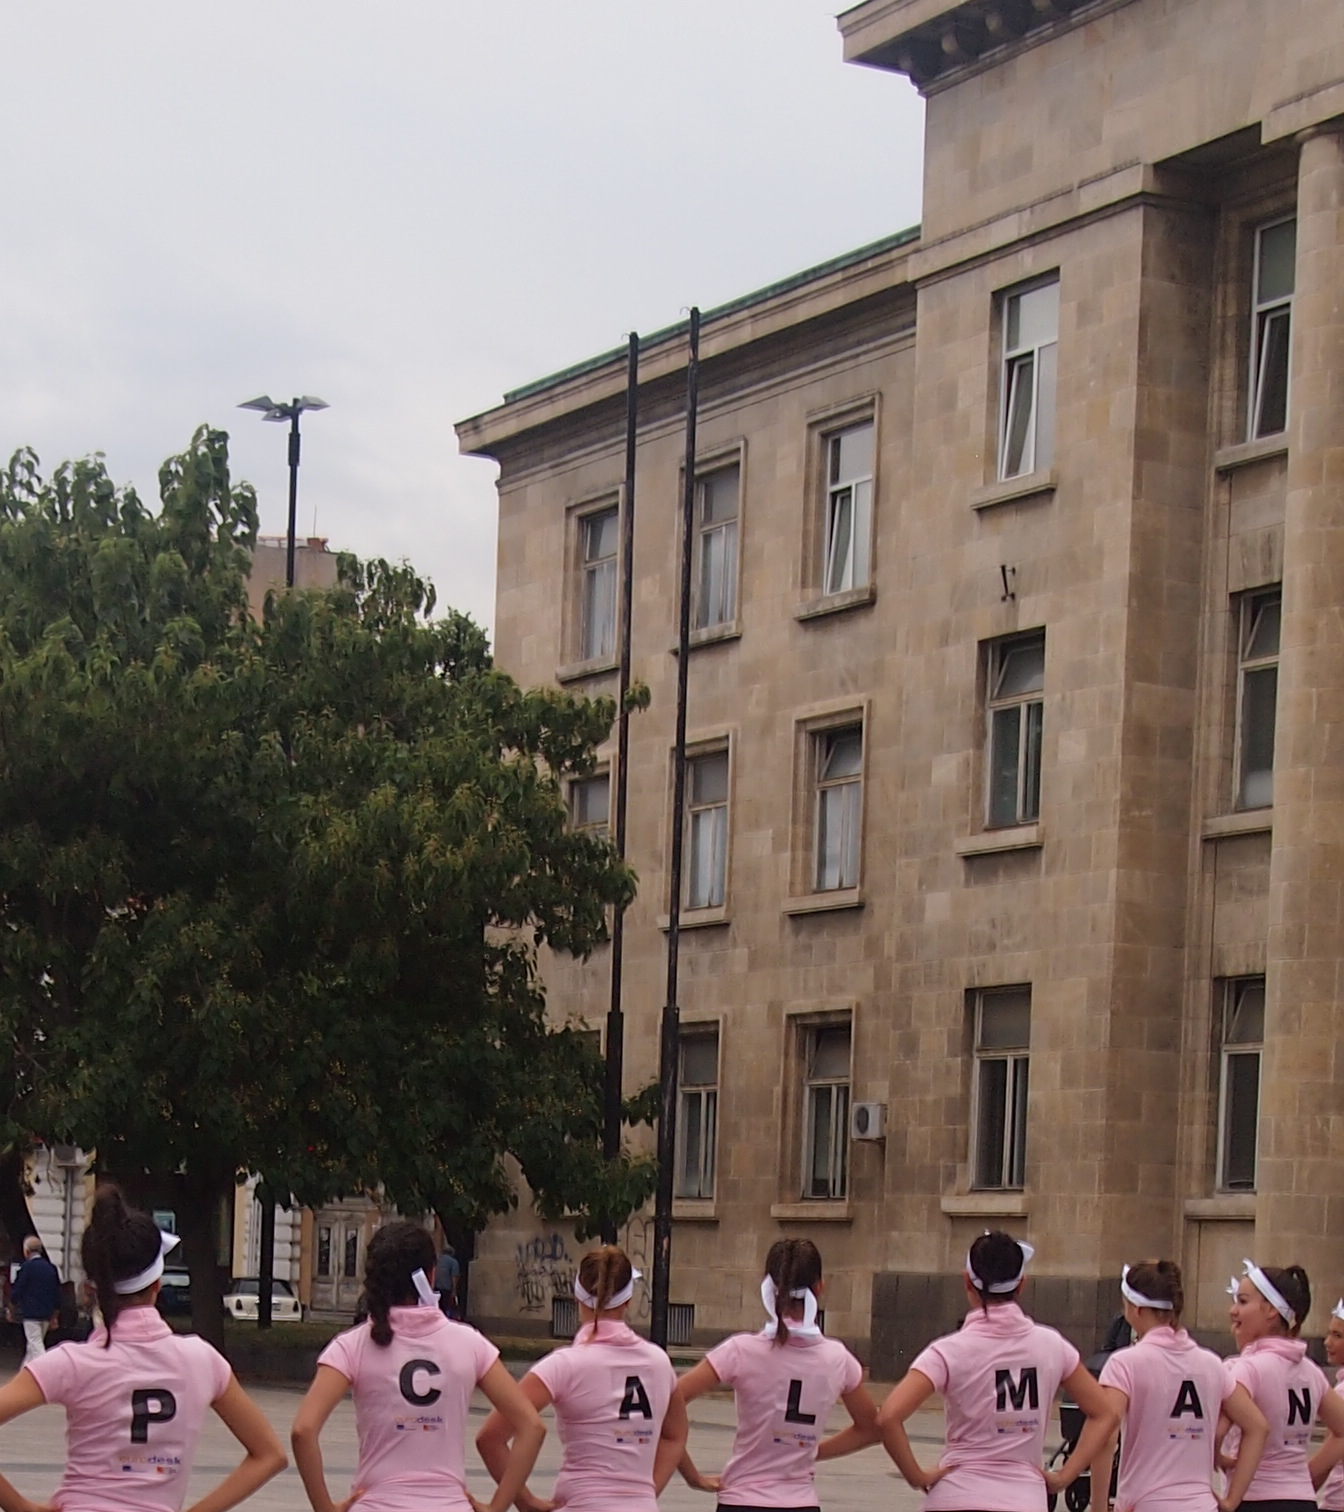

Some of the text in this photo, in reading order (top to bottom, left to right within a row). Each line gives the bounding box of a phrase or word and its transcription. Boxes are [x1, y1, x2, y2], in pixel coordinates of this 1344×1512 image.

[399, 1359, 442, 1407] C
[618, 1375, 653, 1420] A
[784, 1379, 816, 1425] L
[995, 1367, 1039, 1412] M
[1169, 1380, 1203, 1419] A
[131, 1388, 177, 1444] P
[1286, 1388, 1311, 1426] N
